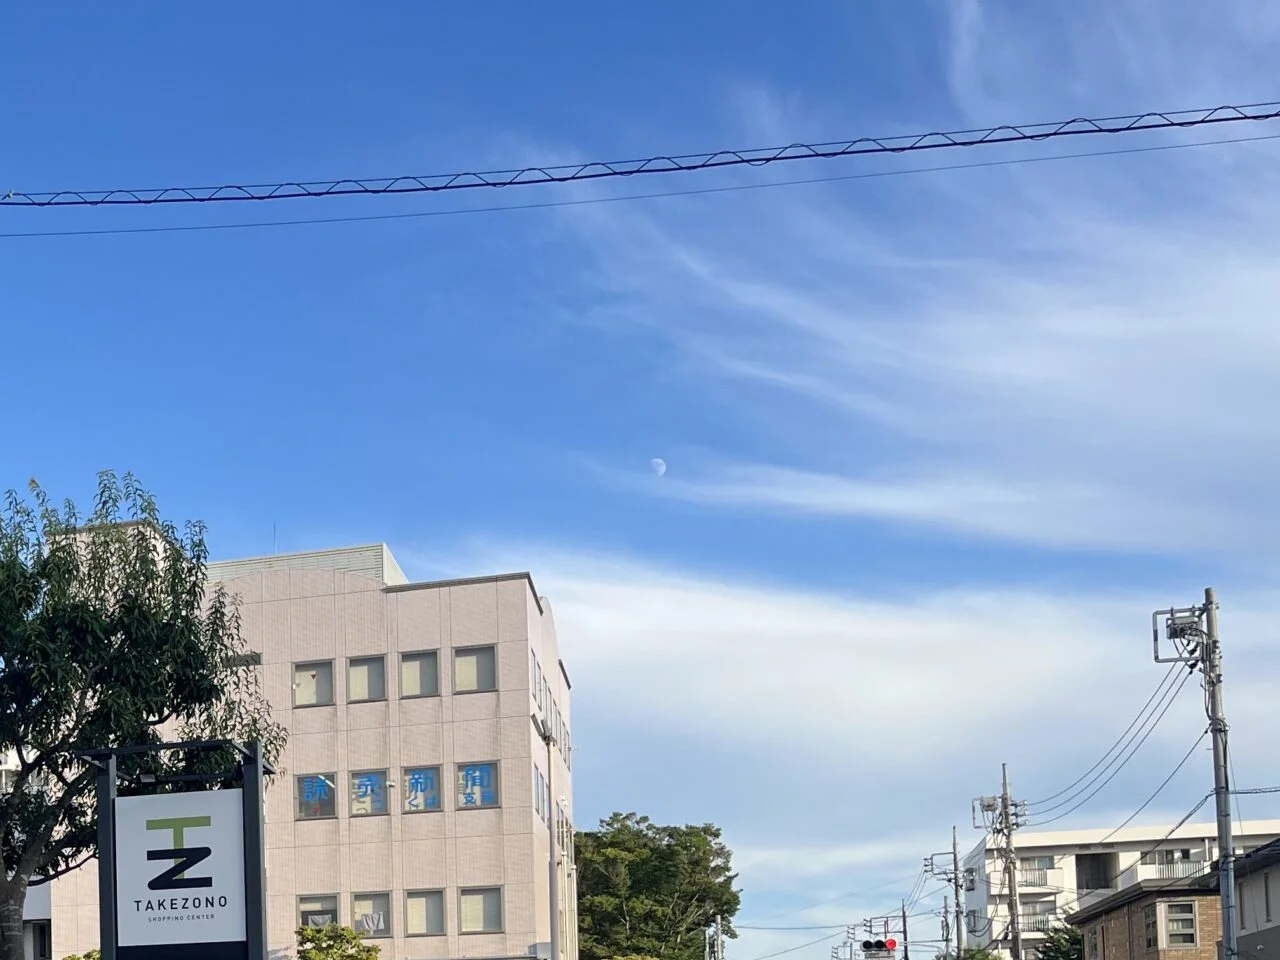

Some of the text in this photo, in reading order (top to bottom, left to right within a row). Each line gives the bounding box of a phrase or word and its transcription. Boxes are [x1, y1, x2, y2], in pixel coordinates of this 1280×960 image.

[133, 895, 228, 912] TAKEZONO
[148, 913, 215, 923] SHOPPING CENTER
